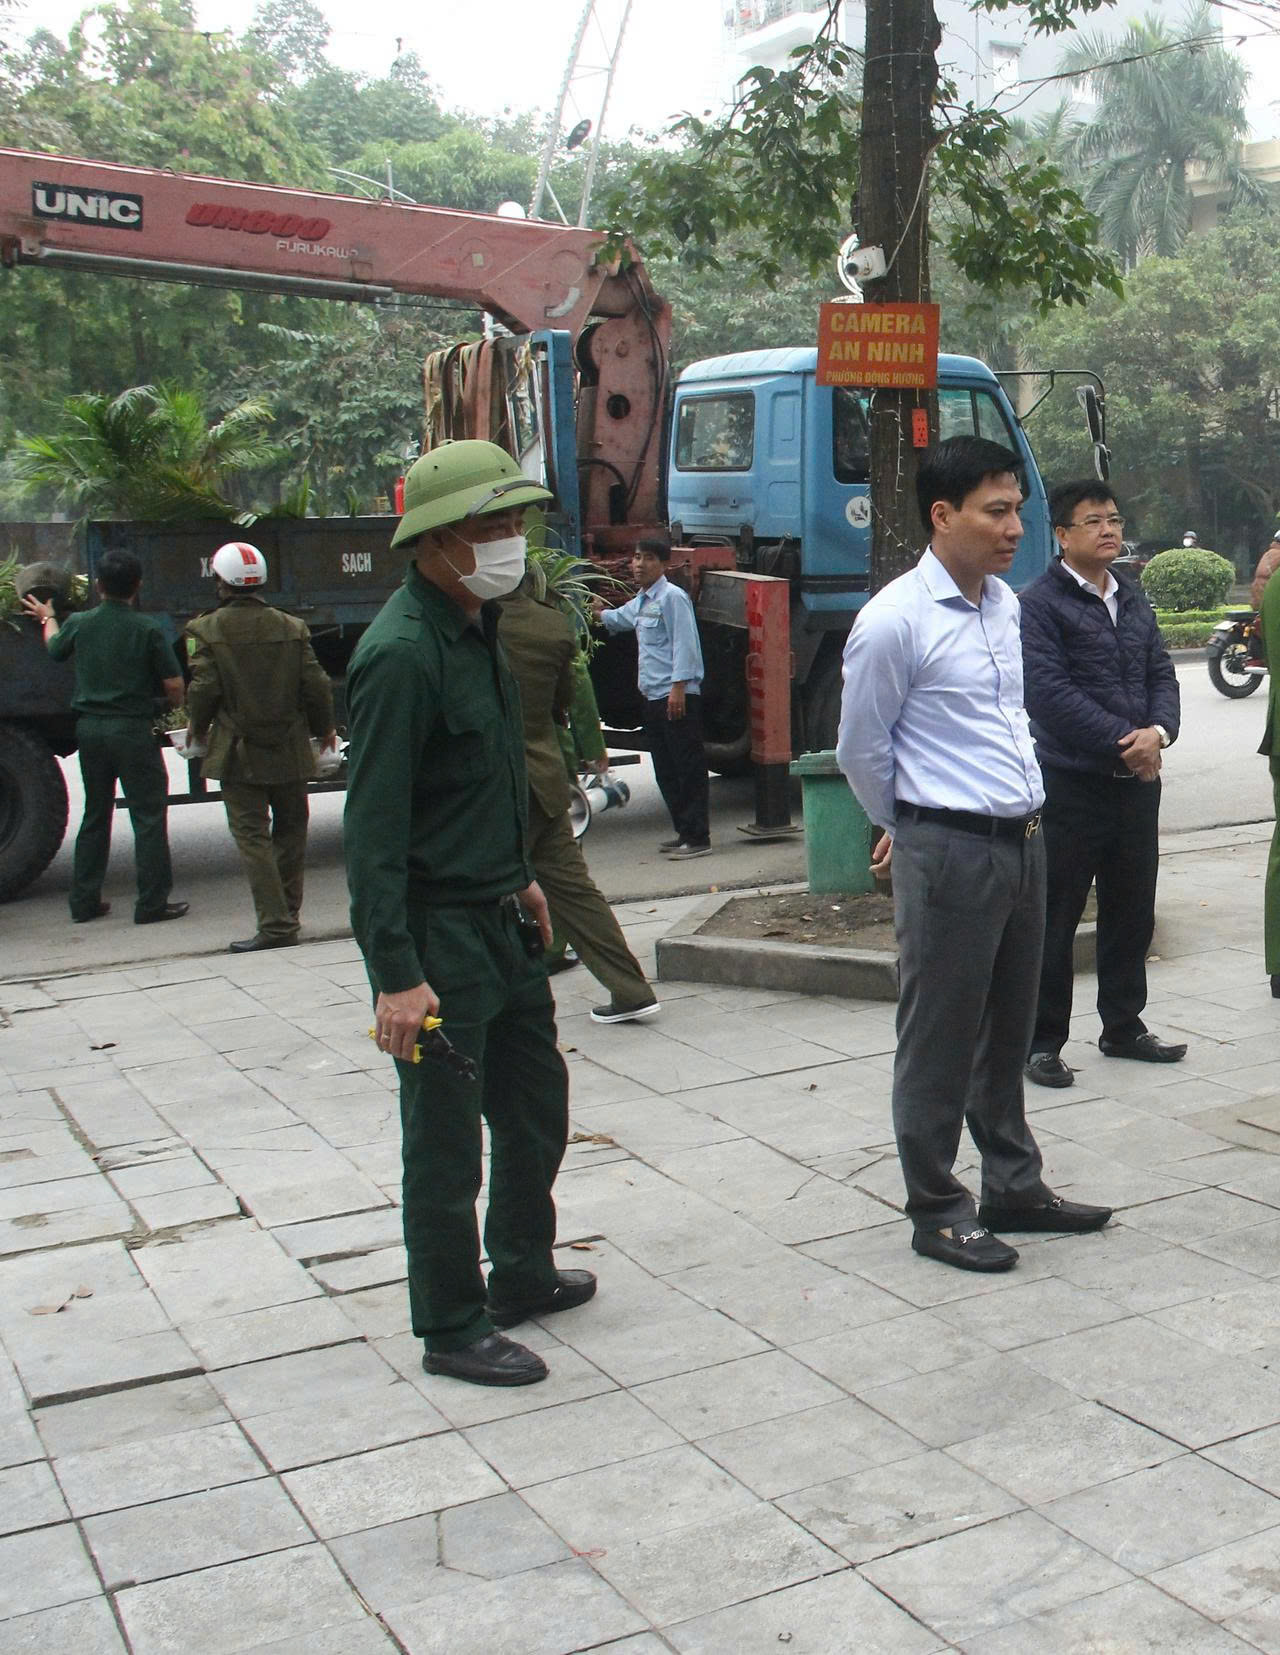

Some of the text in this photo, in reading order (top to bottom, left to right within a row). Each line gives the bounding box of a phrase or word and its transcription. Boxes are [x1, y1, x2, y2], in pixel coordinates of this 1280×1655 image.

[35, 188, 141, 223] UNIC
[831, 312, 926, 334] CAMERA
[829, 341, 925, 364] AN NINH
[342, 552, 372, 577] SẠCH
